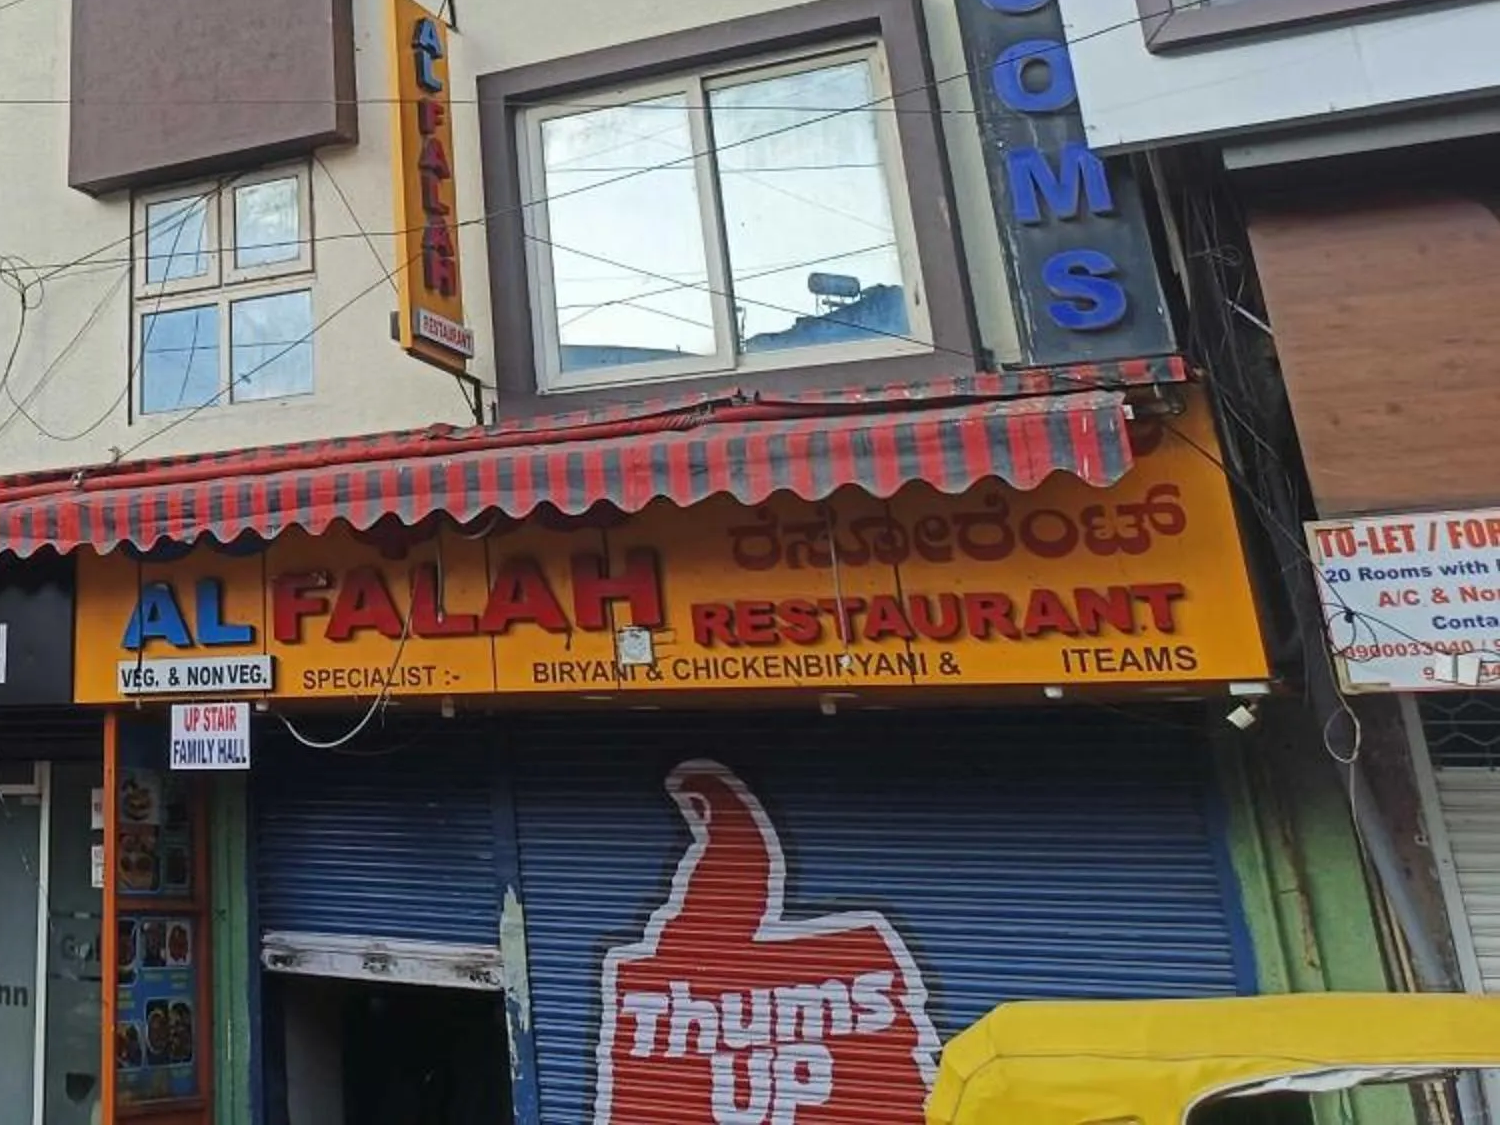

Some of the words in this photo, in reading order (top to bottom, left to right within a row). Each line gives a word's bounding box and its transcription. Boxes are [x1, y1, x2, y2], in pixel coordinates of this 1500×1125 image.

[412, 17, 442, 93] AL
[422, 313, 473, 350] RESTAURANT
[1315, 523, 1416, 558] TO-LET
[1325, 567, 1351, 583] 20
[1358, 564, 1433, 581] Rooms
[1438, 559, 1490, 576] with
[121, 579, 254, 651] AL
[272, 547, 666, 645] FALAH
[1431, 586, 1449, 605] &
[690, 583, 1185, 650] RESTAURANT
[121, 669, 159, 689] VEG.
[169, 668, 181, 687] &
[187, 666, 223, 686] NON
[227, 664, 268, 685] VEG.
[302, 665, 437, 690] SPECIALIST
[533, 660, 636, 684] BIRYANI
[645, 664, 664, 682] &
[672, 651, 927, 681] CHICKENBIRYANI
[939, 652, 961, 676] &
[1061, 645, 1198, 674] ITEAMS
[183, 708, 201, 733] UP
[204, 706, 238, 731] STAIR
[173, 739, 215, 765] FAMILY
[218, 736, 247, 764] HALL
[621, 970, 897, 1058] Thums
[711, 1042, 834, 1125] UP
